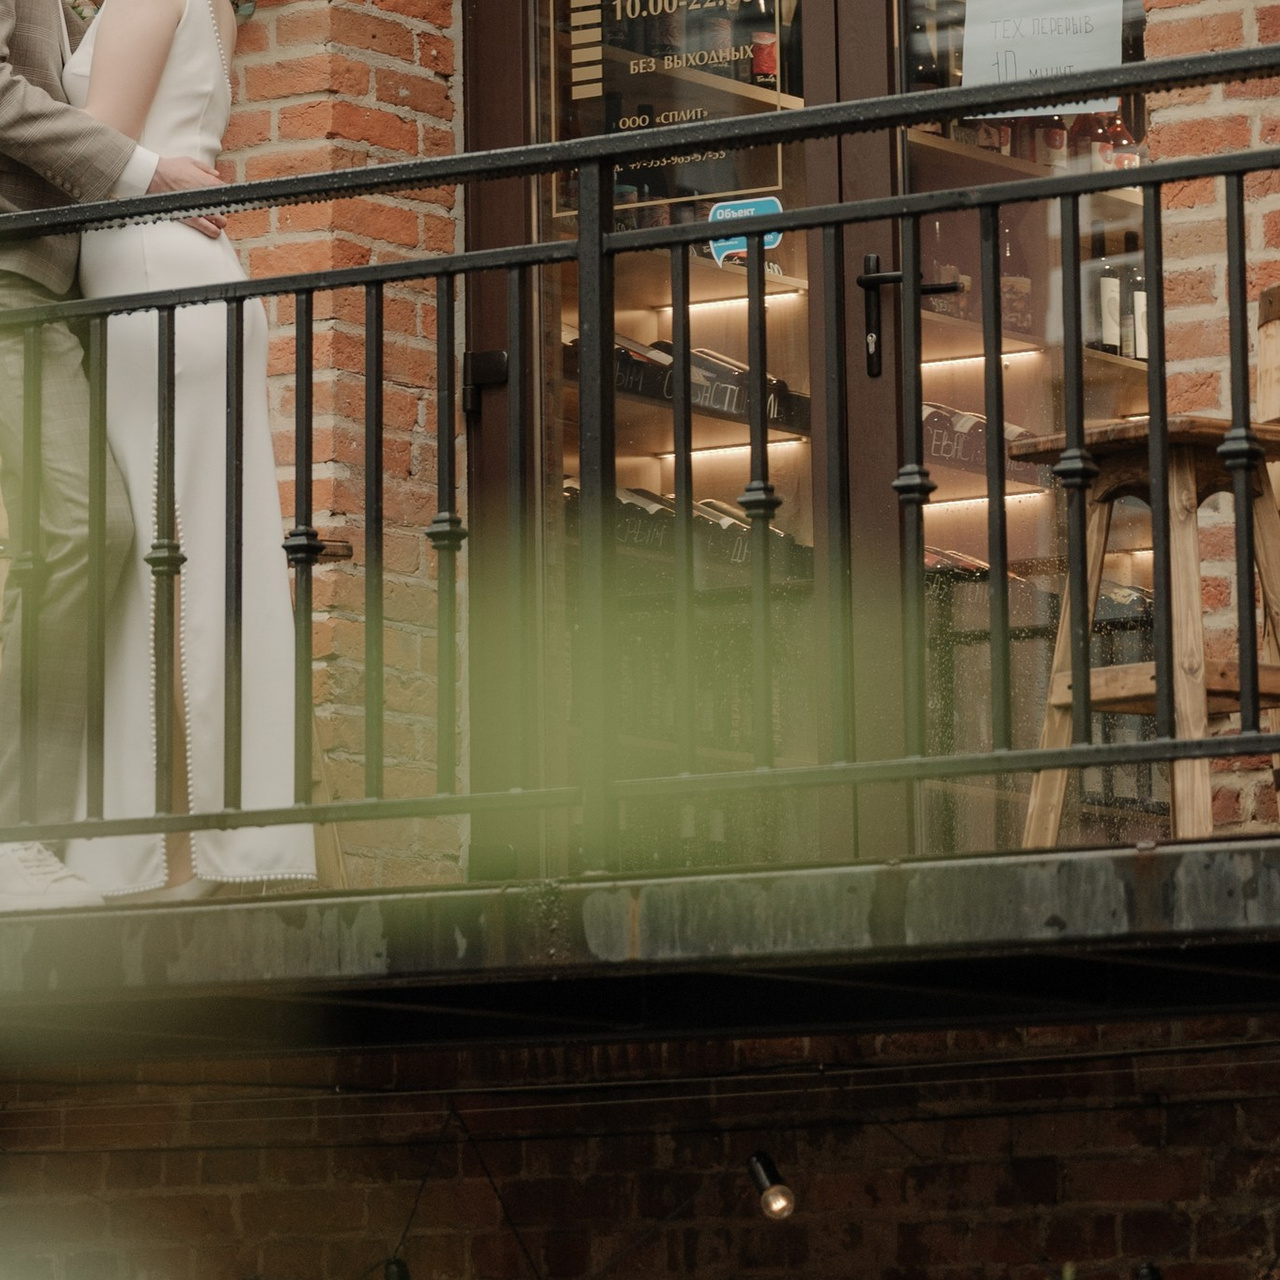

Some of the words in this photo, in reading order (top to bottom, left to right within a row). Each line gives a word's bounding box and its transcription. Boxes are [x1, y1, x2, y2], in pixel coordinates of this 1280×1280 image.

[990, 18, 1024, 40] ТЕХ
[1032, 16, 1094, 36] ПЕРЕРЫВ
[630, 57, 656, 74] БЕЗ
[664, 44, 755, 70] ВЫХОДНЫХ
[991, 50, 1018, 83] 10
[619, 115, 650, 130] ООО
[655, 107, 709, 124] «СПЛИТ»
[716, 208, 756, 220] Объект
